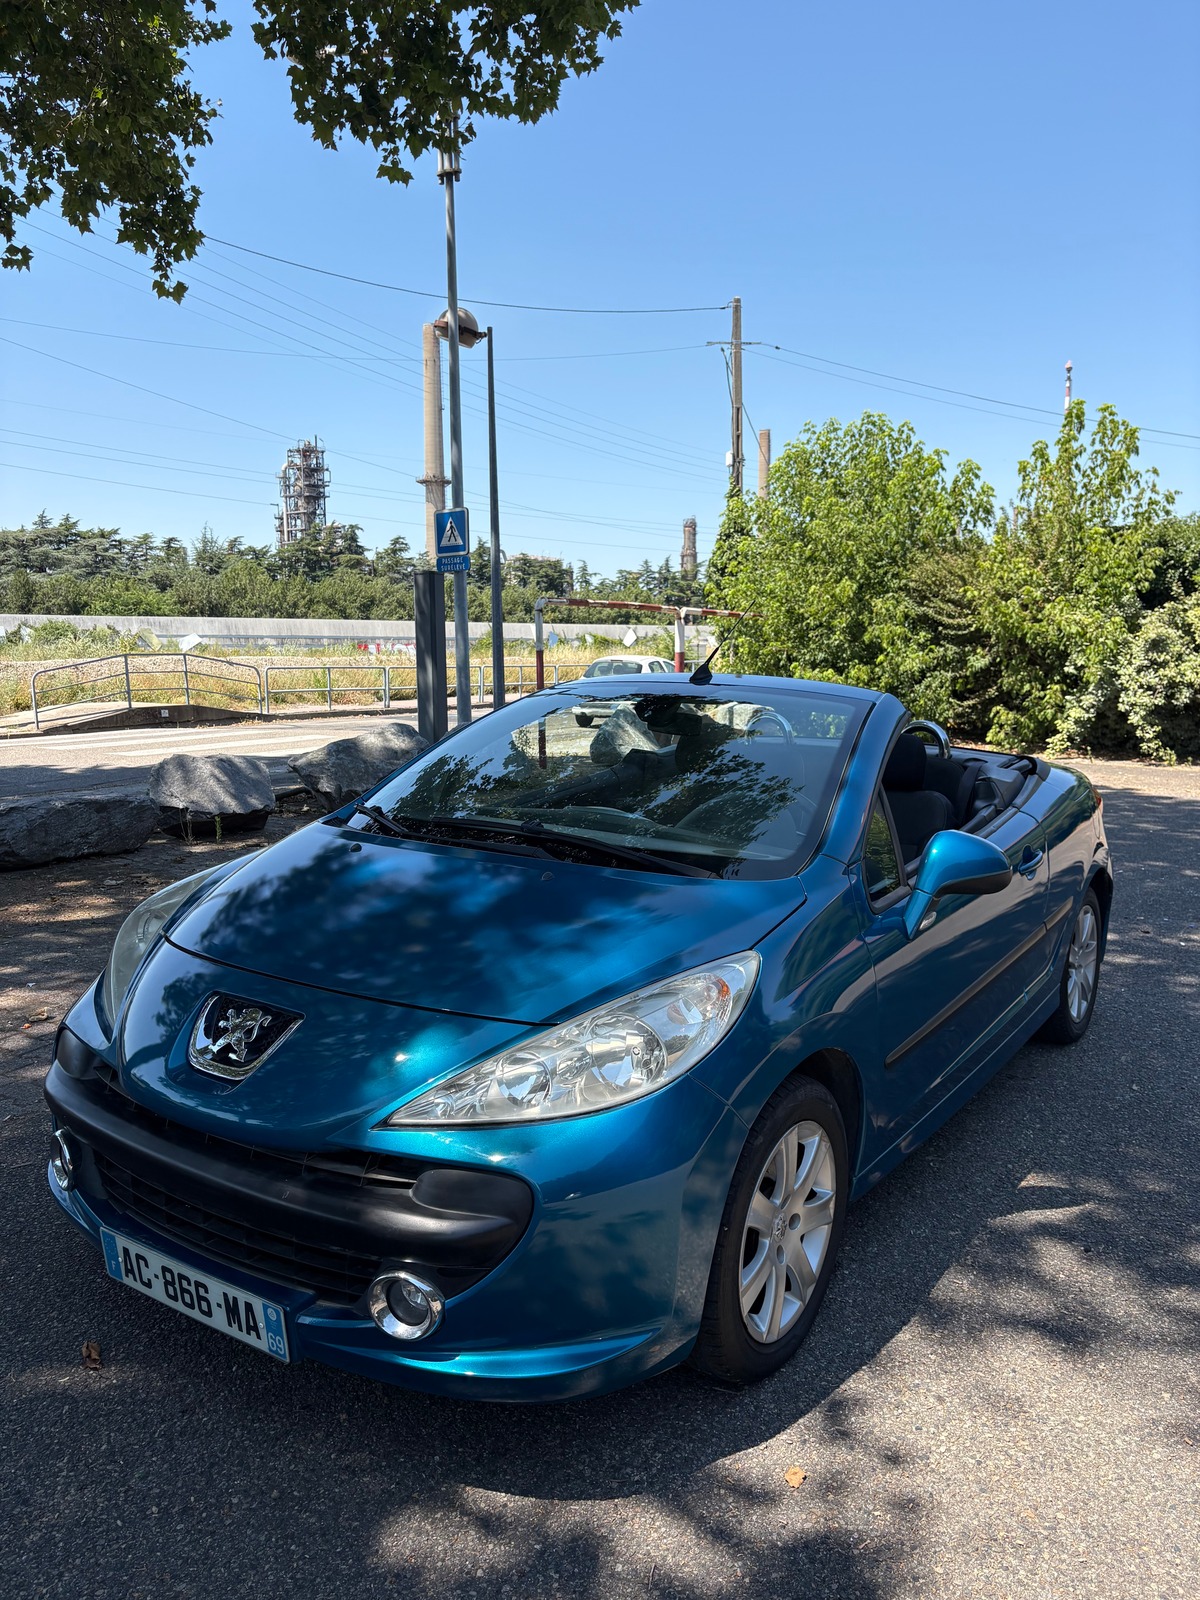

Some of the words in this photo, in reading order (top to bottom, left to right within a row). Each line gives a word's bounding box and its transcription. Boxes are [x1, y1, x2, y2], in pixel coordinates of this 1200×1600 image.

[111, 1260, 116, 1270] F
[122, 1246, 262, 1340] AC-866-MA
[268, 1332, 285, 1355] 69
